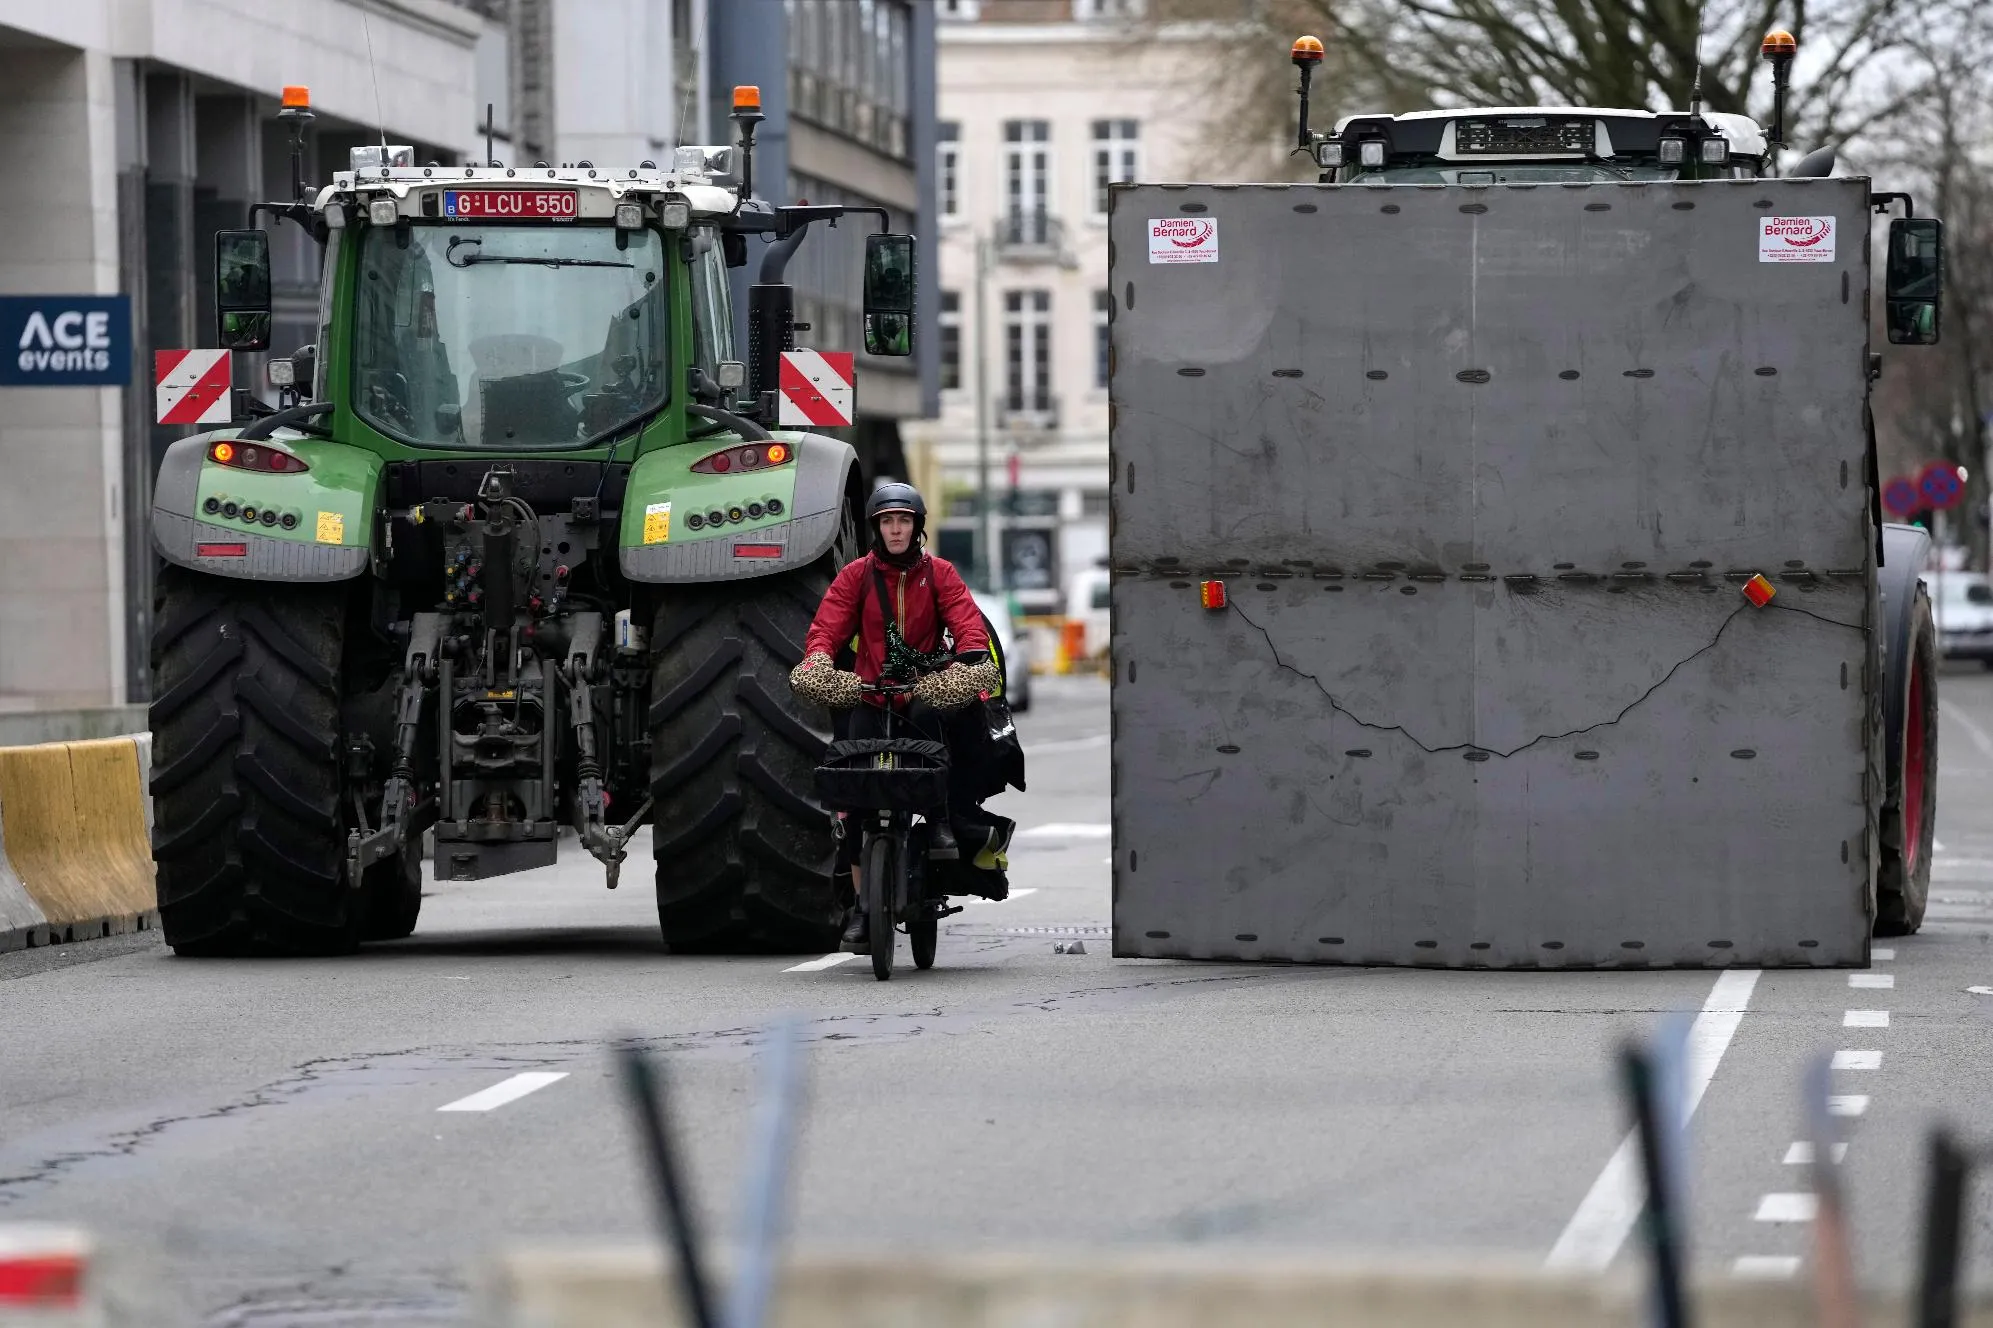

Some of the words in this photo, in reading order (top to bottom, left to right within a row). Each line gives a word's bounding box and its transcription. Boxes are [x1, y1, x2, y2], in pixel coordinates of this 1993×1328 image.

[447, 205, 455, 214] B
[1160, 219, 1194, 228] Damien
[1773, 217, 1810, 226] Damien
[1153, 227, 1197, 237] Bernard
[1765, 225, 1813, 235] Bernard
[19, 311, 110, 349] ACE
[18, 348, 110, 372] events
